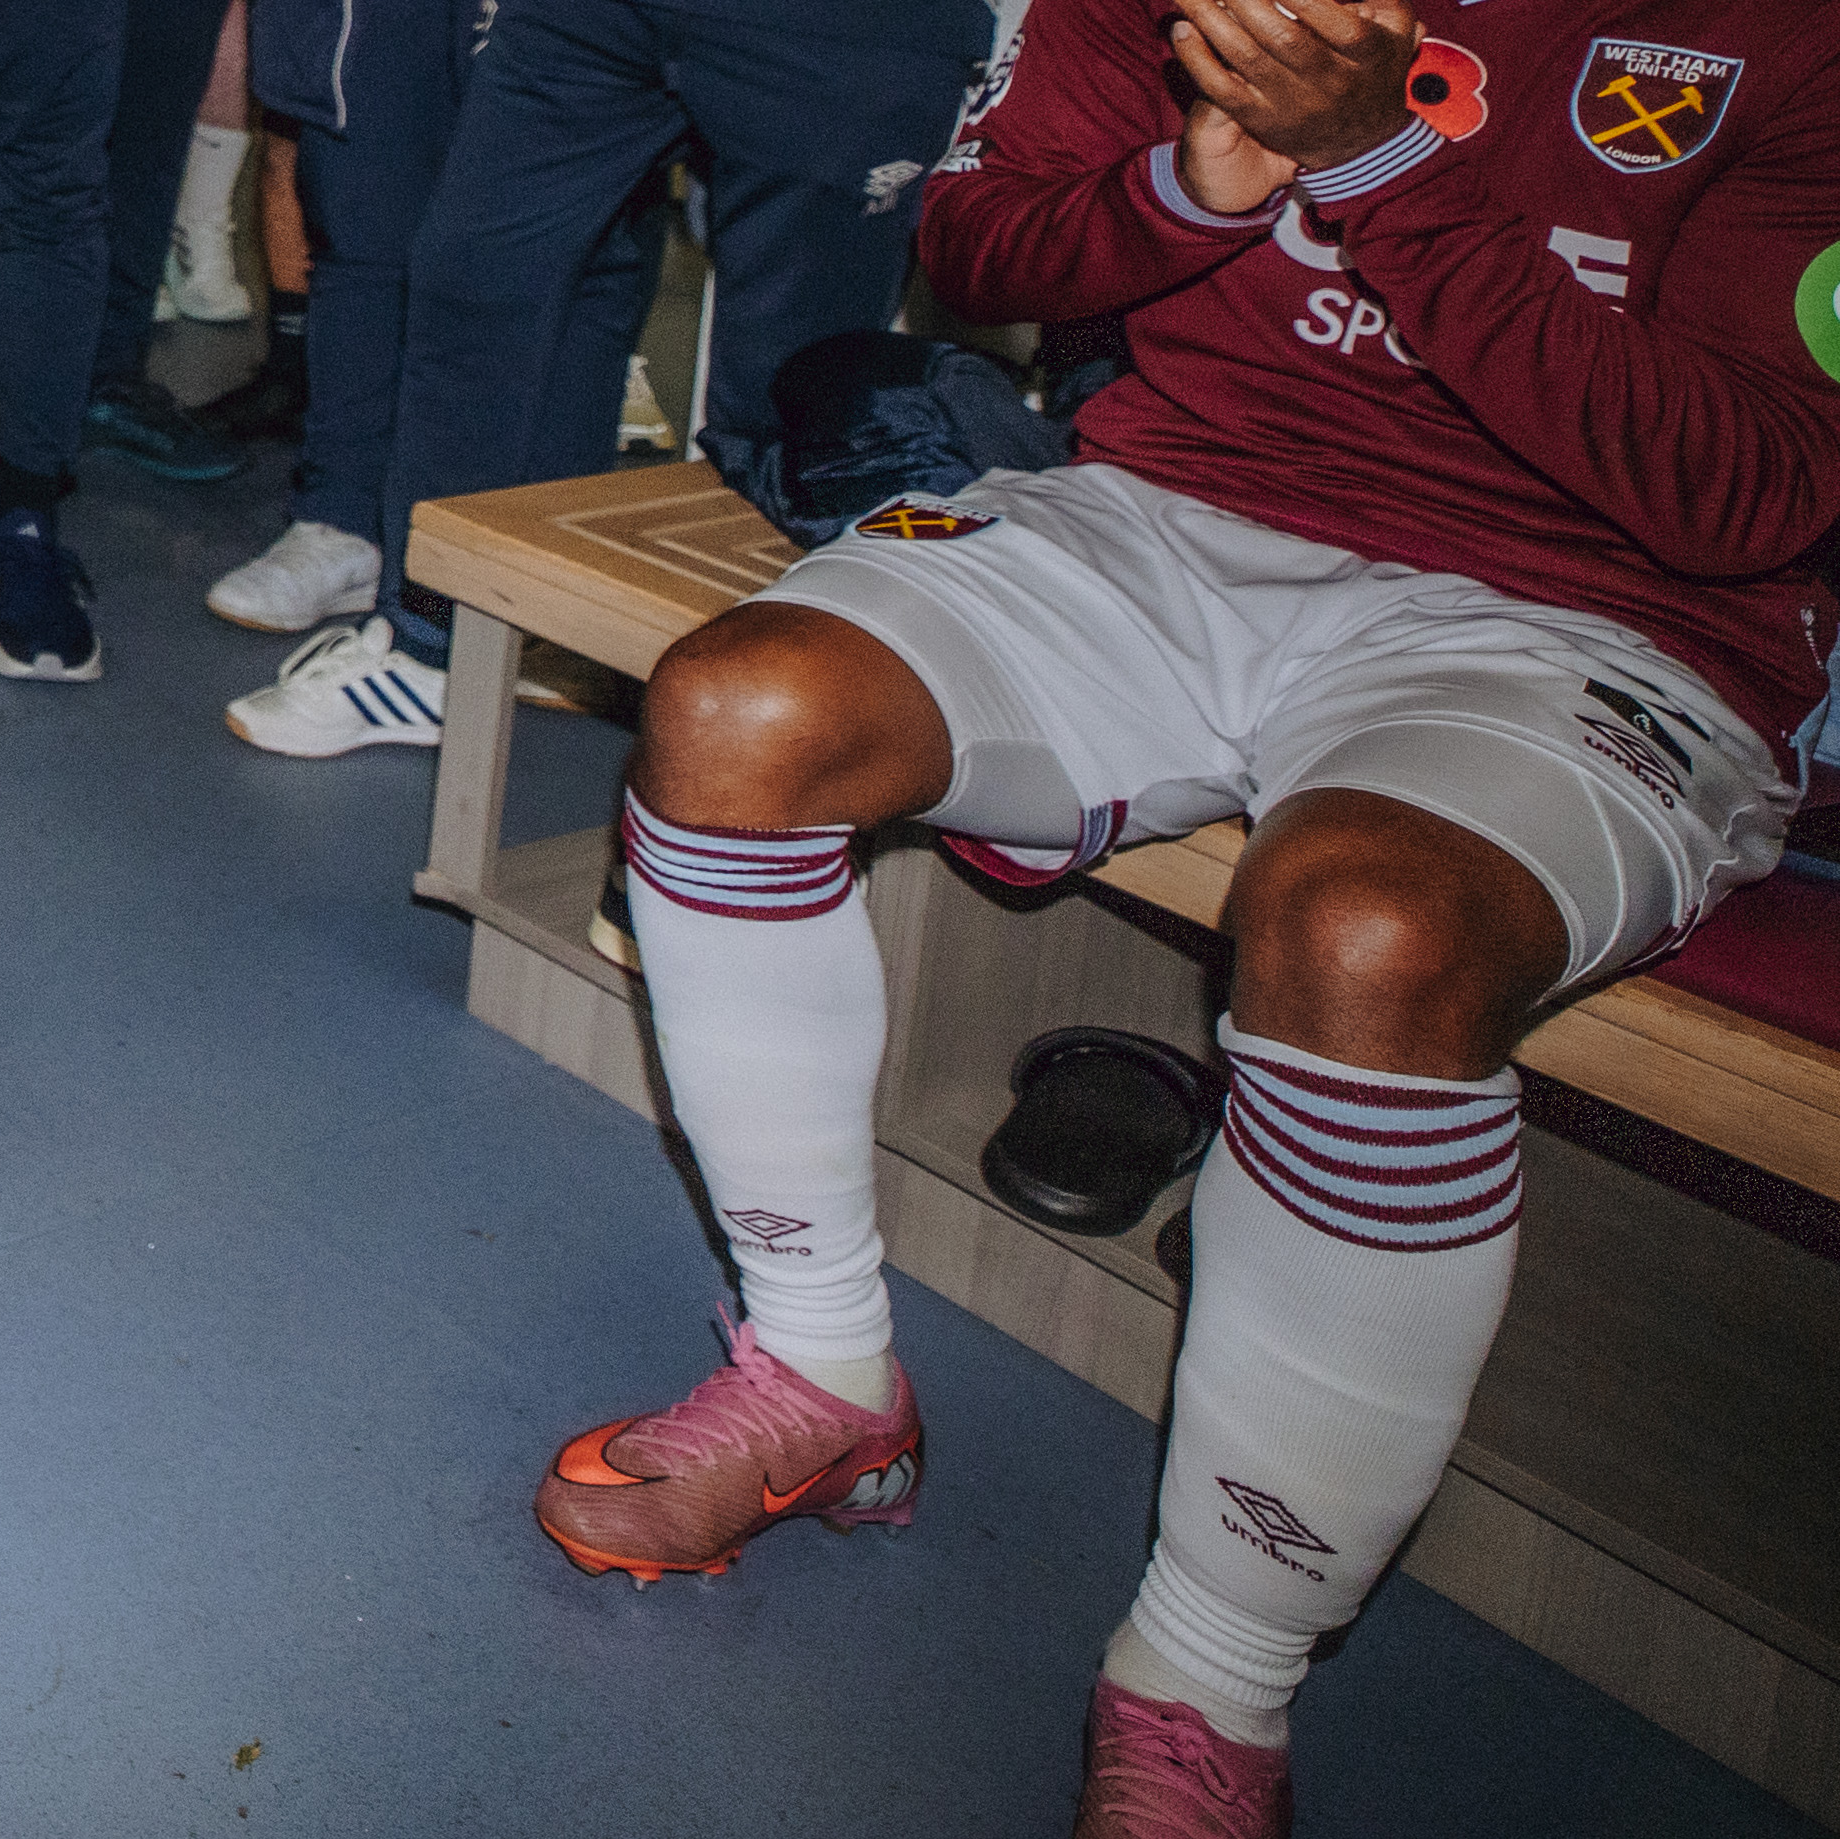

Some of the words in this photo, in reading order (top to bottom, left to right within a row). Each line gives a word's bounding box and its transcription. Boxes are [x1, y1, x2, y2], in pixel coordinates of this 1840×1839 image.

[1604, 45, 1669, 65] WEST
[1670, 54, 1728, 79] HAM
[1625, 61, 1700, 84] UNITED
[1605, 145, 1662, 164] LONDON
[1583, 735, 1675, 810] umbro
[1221, 1512, 1326, 1583] umbro
